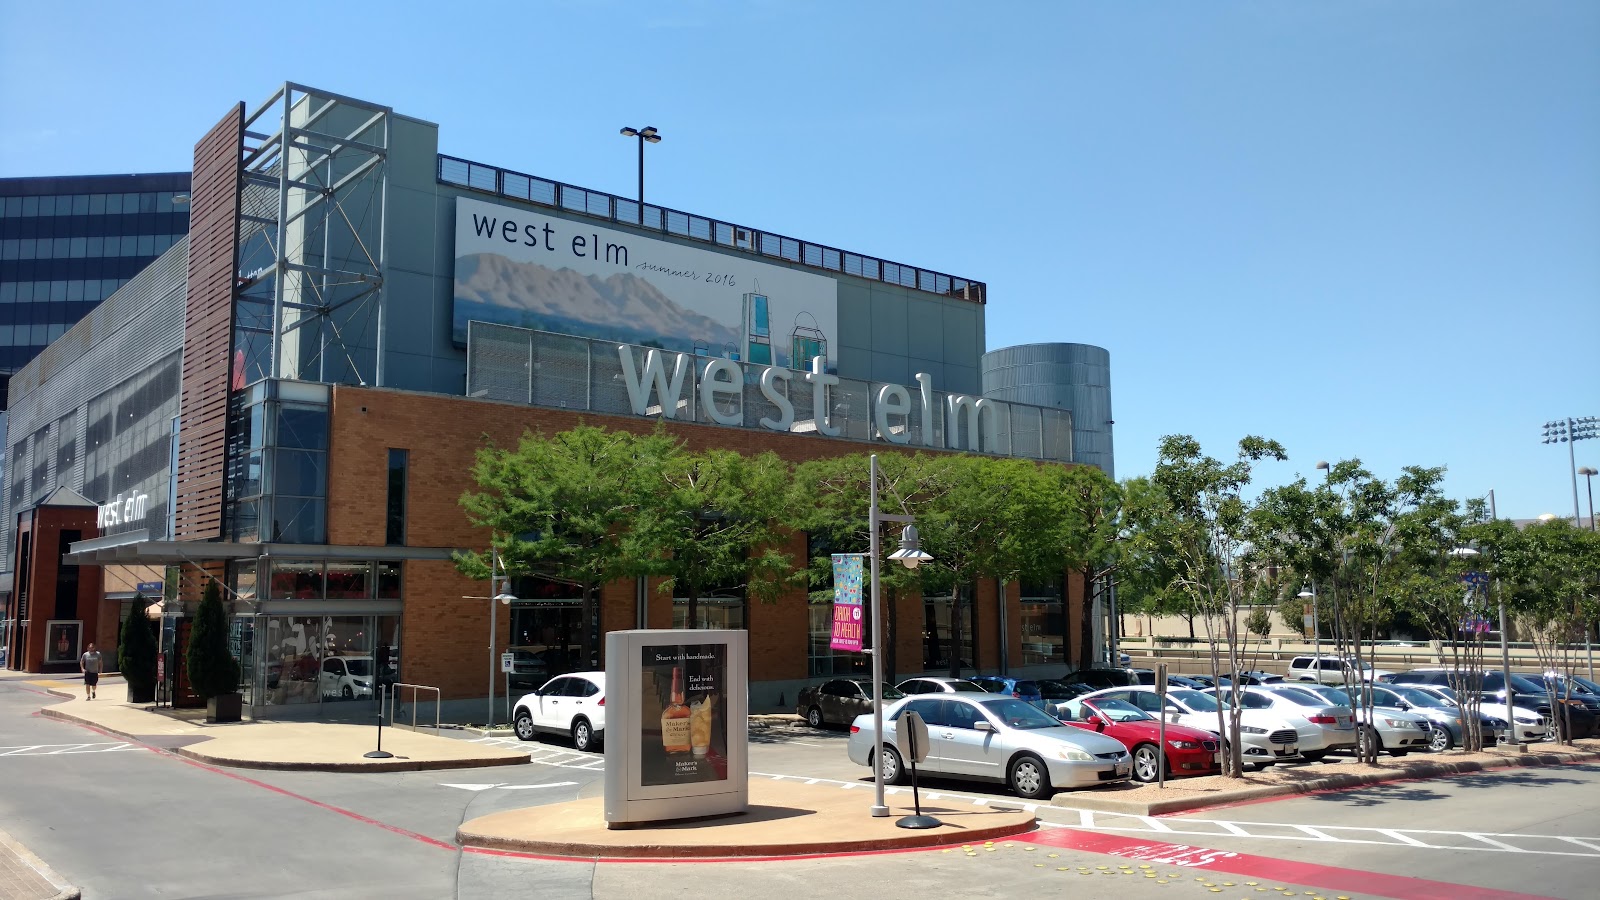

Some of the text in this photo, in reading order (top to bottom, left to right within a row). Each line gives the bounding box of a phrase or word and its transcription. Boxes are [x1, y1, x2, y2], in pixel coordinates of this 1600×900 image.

[472, 213, 628, 267] west elm
[635, 261, 737, 287] summer 2016
[618, 344, 1000, 454] west elm
[97, 489, 148, 529] west elm
[841, 622, 860, 639] HEALTH
[656, 653, 671, 661] Start
[686, 652, 715, 660] handmade.
[322, 687, 348, 697] west
